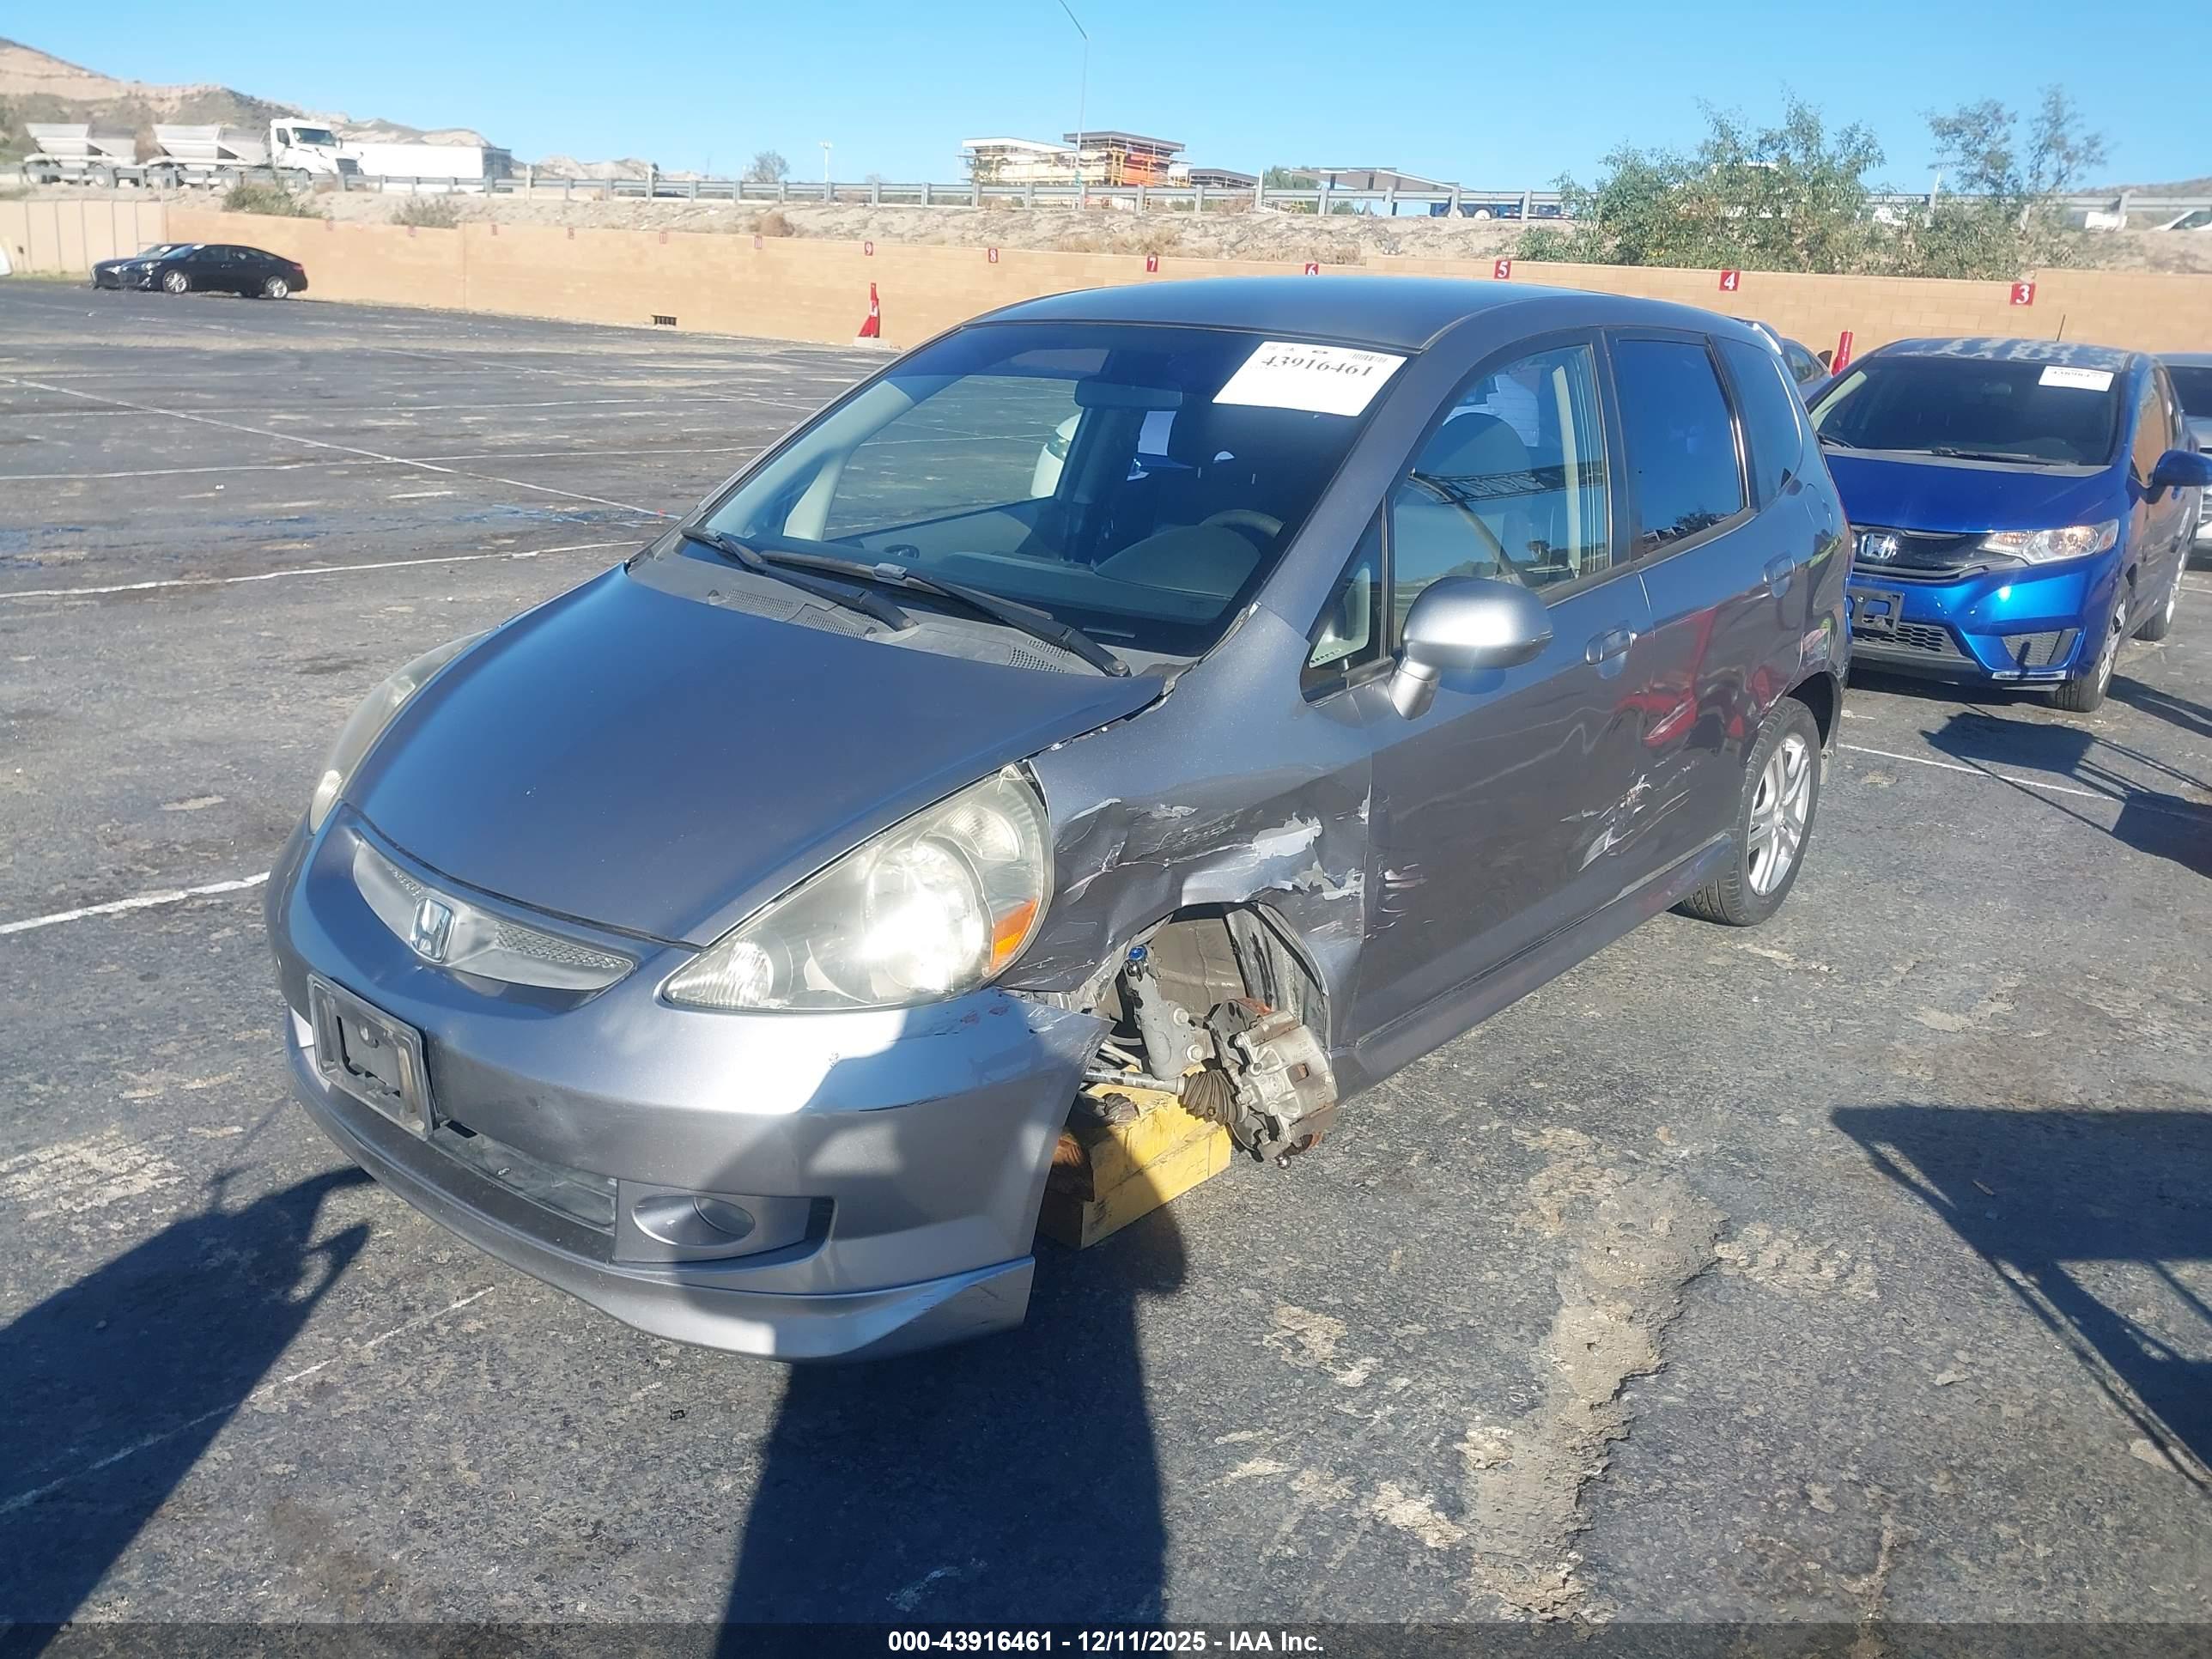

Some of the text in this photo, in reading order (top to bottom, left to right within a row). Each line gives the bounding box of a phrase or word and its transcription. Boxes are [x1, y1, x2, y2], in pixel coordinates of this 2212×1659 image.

[866, 241, 872, 254] 9
[989, 248, 998, 262] 8
[1149, 257, 1158, 270] 7
[1307, 264, 1316, 275] 6
[1497, 261, 1508, 278] 5
[1723, 273, 1735, 289] 4
[2015, 285, 2030, 304] 3
[1261, 356, 1373, 376] 43916461
